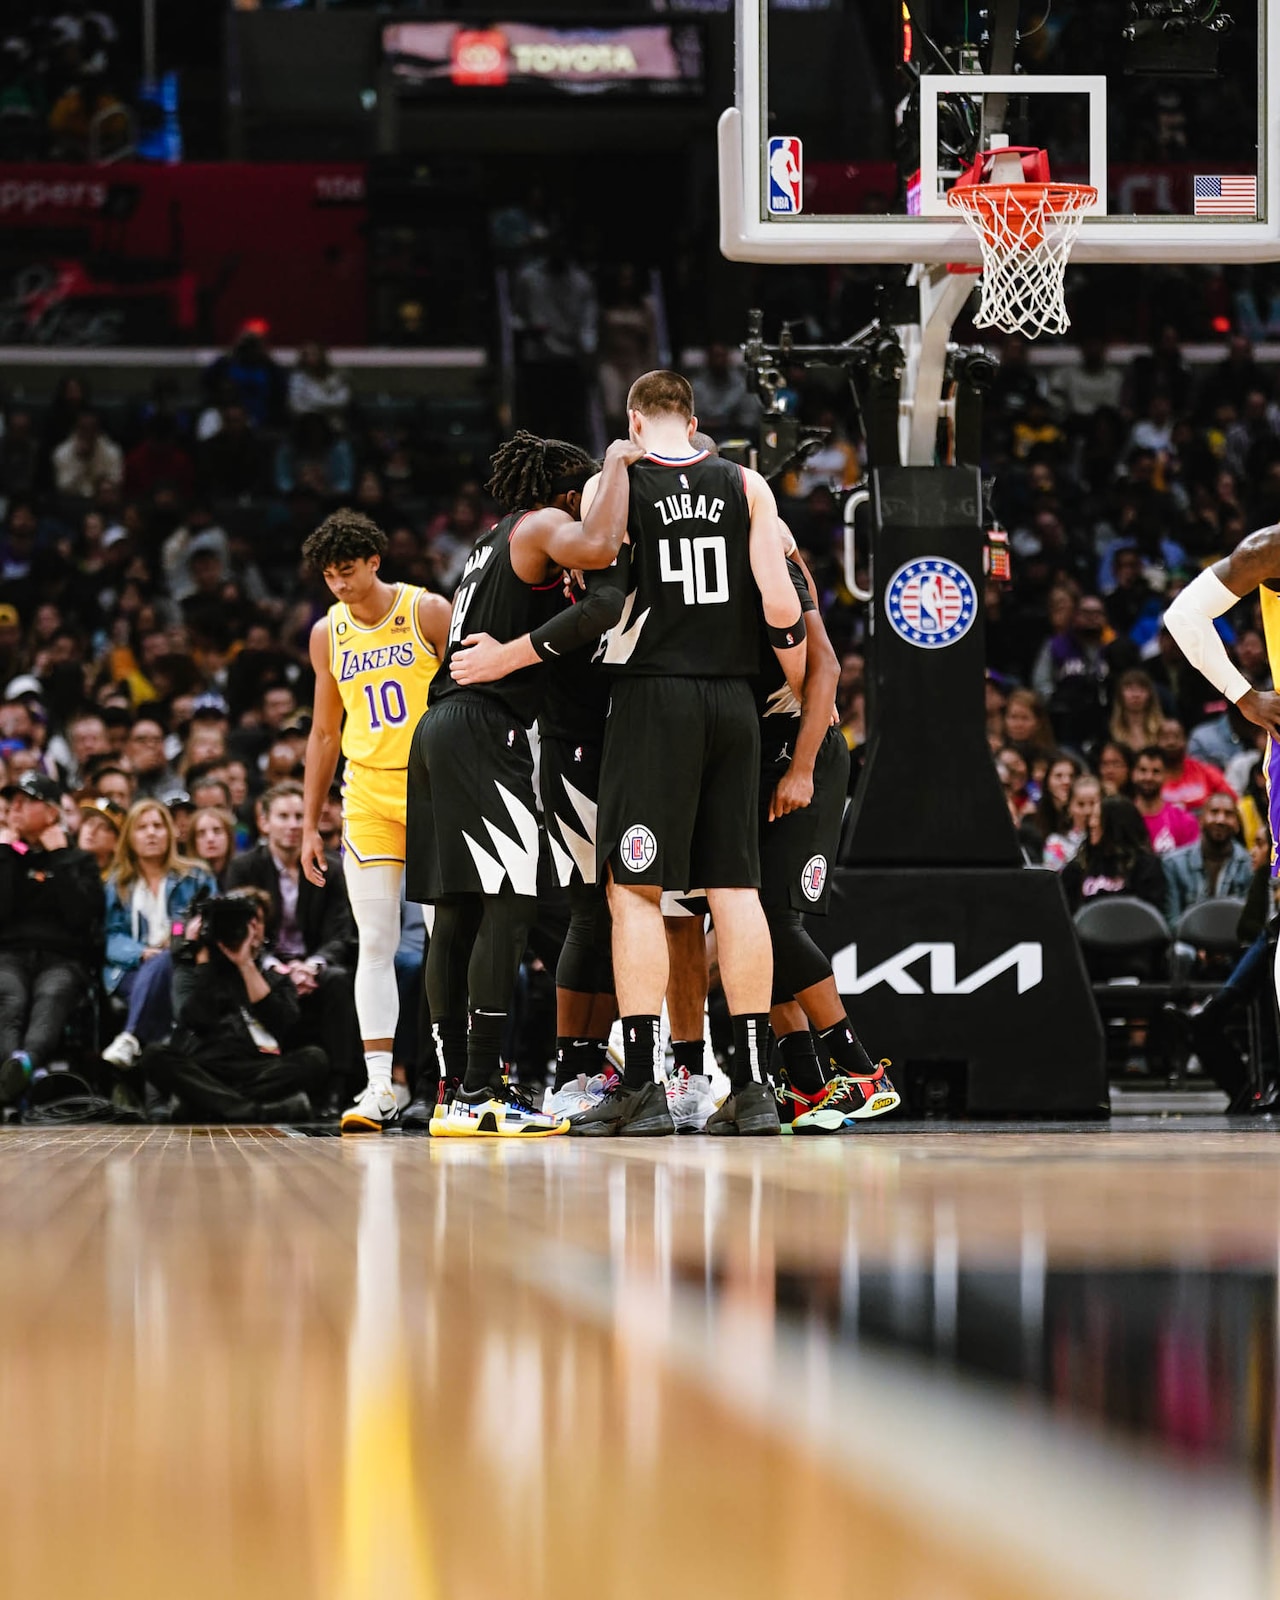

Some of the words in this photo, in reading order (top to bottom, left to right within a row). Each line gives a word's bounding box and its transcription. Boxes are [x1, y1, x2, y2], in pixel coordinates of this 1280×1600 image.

[511, 44, 637, 73] TOYOTA
[772, 196, 790, 210] NBA
[654, 493, 726, 526] ZUBAC
[659, 536, 729, 605] 40
[339, 642, 416, 682] LAKERS
[364, 680, 408, 729] 10
